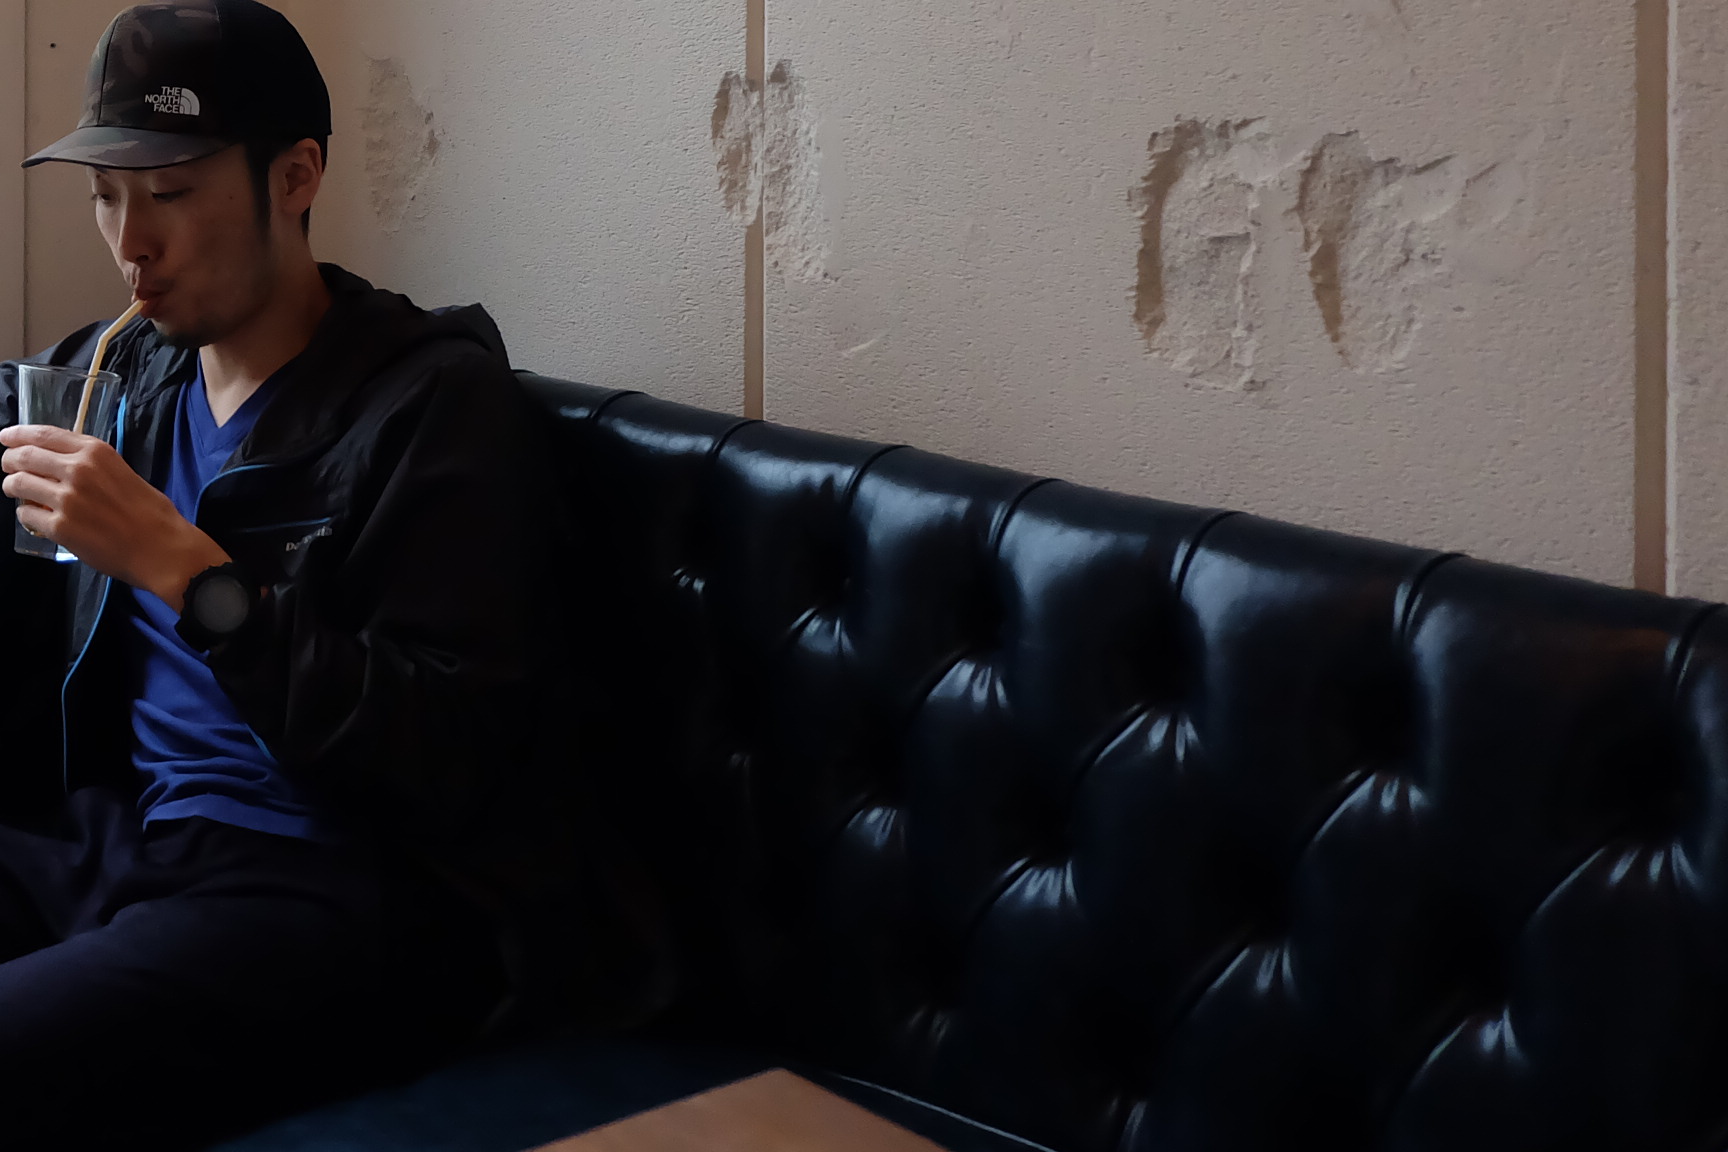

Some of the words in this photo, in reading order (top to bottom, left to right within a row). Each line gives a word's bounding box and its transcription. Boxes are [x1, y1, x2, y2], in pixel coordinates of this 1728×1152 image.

[161, 86, 181, 96] THE
[145, 94, 180, 104] NORTH
[153, 103, 179, 114] FACE
